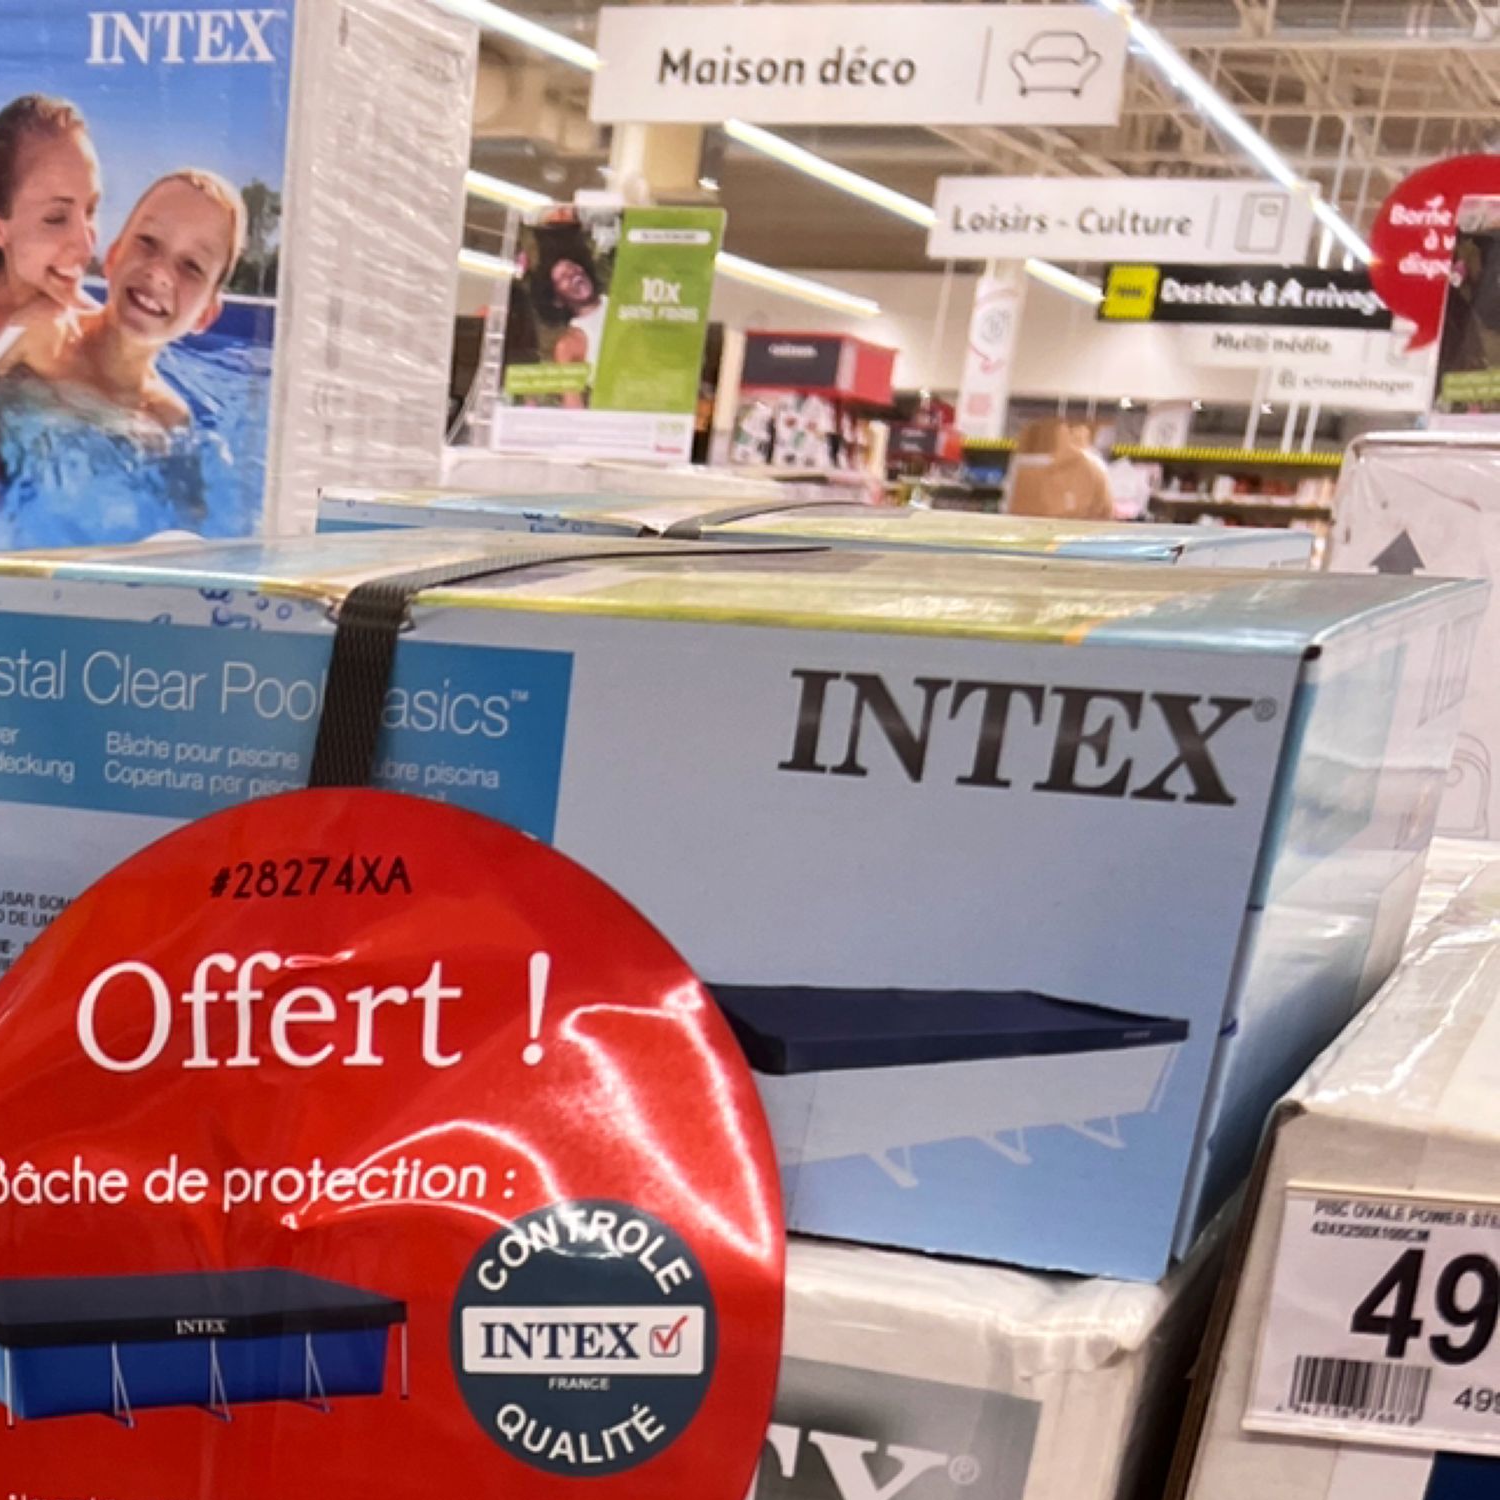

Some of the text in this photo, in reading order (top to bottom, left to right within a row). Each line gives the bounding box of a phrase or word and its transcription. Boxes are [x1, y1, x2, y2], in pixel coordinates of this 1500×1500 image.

[86, 9, 277, 65] INTEX
[657, 47, 917, 86] Maison déco
[950, 205, 1048, 235] Loisirs
[1078, 205, 1194, 238] Culture
[82, 650, 207, 712] Clear
[220, 660, 328, 721] Pool
[380, 676, 511, 738] asics
[106, 731, 499, 789] Bâche pour piscine ubre piscina
[776, 667, 1256, 807] INTEX
[104, 761, 204, 791] Copertura
[210, 772, 245, 796] per
[208, 855, 413, 900] #28274XA
[8, 911, 29, 926] DE
[75, 949, 464, 1074] Offert
[143, 1155, 209, 1204] de
[222, 1159, 488, 1213] protection
[478, 1210, 693, 1295] CONTROLE
[175, 1318, 227, 1336] INTEX
[480, 1321, 640, 1360] INTEX
[548, 1377, 610, 1391] FRANCE
[496, 1402, 666, 1465] QUALITÉ
